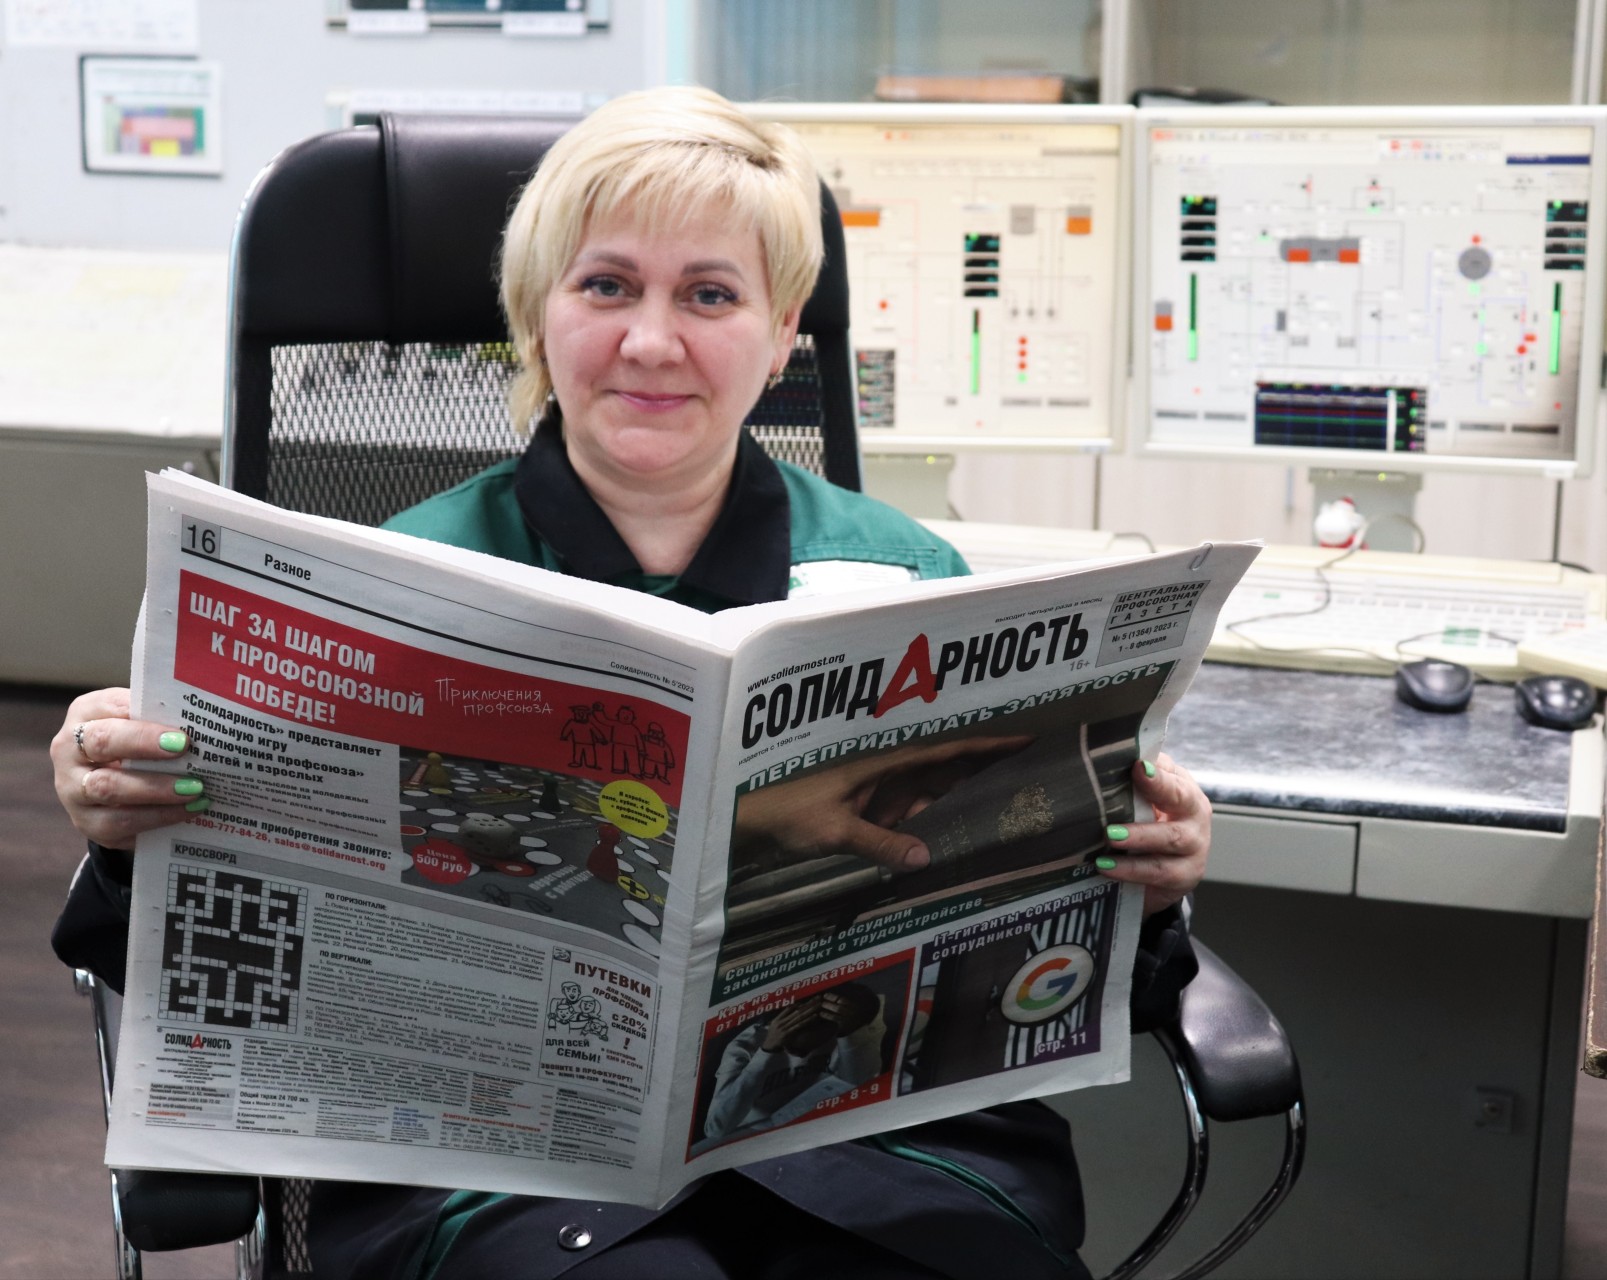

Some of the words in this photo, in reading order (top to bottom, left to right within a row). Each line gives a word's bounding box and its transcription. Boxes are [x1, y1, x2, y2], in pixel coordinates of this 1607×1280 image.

[187, 524, 216, 554] 16
[264, 553, 311, 581] Разное
[1114, 590, 1199, 614] ПРОФСОЮЗНАЯ
[1118, 582, 1205, 604] ЦЕНТРАЛЬНАЯ
[190, 592, 241, 628] ШАГ
[247, 613, 276, 643] ЗА
[285, 626, 375, 675] ШАГОМ
[1112, 633, 1121, 643] №
[1122, 632, 1128, 640] 5
[1128, 626, 1152, 640] (1364)
[1153, 624, 1170, 635] 2023
[1129, 642, 1135, 650] 8
[1136, 634, 1167, 649] февраля
[211, 632, 225, 656] К
[233, 640, 424, 717] ПРОФСОЮЗНОЙ
[610, 661, 661, 682] Солидарность
[741, 613, 1089, 750] СОЛИДАРНОСТЬ
[747, 653, 846, 694] www.solidarnost.org
[1070, 659, 1090, 672] 16+
[236, 673, 336, 724] ПОБЕДЕ!
[181, 709, 254, 743] настольную
[258, 735, 287, 753] игру
[183, 693, 284, 735] «Солидарность»
[288, 730, 382, 758] представляет
[749, 706, 994, 792] ПЕРЕПРИДУМАТЬ
[1003, 662, 1162, 716] ЗАНЯТОСТЬ
[180, 725, 273, 762] «Приключения
[277, 755, 365, 779] профсоюза»
[738, 748, 769, 766] издается
[777, 737, 793, 749] 1990
[794, 731, 811, 742] года
[203, 749, 240, 768] детей
[245, 760, 252, 769] и
[257, 763, 324, 784] взрослых
[174, 843, 237, 865] КРОССВОРД
[261, 821, 339, 847] приобретения
[343, 840, 392, 860] звоните:
[275, 838, 386, 871] sales@solidarnost.org
[416, 854, 439, 867] 500
[442, 861, 467, 875] руб.
[325, 892, 335, 900] ПО
[336, 894, 387, 911] ГОРИЗОНТАЛИ:
[933, 911, 1019, 948] IT-гиганты
[1026, 882, 1114, 919] сокращают
[319, 950, 330, 958] ПО
[331, 952, 373, 966] ВЕРТИКАЛИ:
[723, 946, 832, 995] законопроект
[838, 942, 846, 952] о
[853, 897, 982, 947] трудоустройстве
[725, 936, 832, 982] Соцпартнеры
[838, 908, 912, 941] обсудили
[932, 923, 1031, 961] сотрудников
[575, 962, 652, 999] ПУТЕВКИ
[718, 1003, 746, 1020] Как
[751, 992, 769, 1005] не
[775, 956, 876, 997] отвлекаться
[592, 987, 650, 1021] ПРОФСОЮЗА
[716, 1021, 733, 1033] от
[737, 996, 795, 1026] работы
[611, 1022, 647, 1040] СКИДКОЙ
[621, 1015, 648, 1033] 20%
[164, 1032, 232, 1050] СОЛИДАРНОСТЬ
[545, 1038, 564, 1048] ДЛЯ
[566, 1038, 590, 1048] ВСЕЙ
[557, 1048, 602, 1064] СЕМЬИ!
[1037, 1039, 1066, 1054] стр.
[1071, 1032, 1087, 1046] 11
[816, 1097, 845, 1111] стр.
[850, 1089, 859, 1100] 8
[870, 1083, 879, 1095] 9
